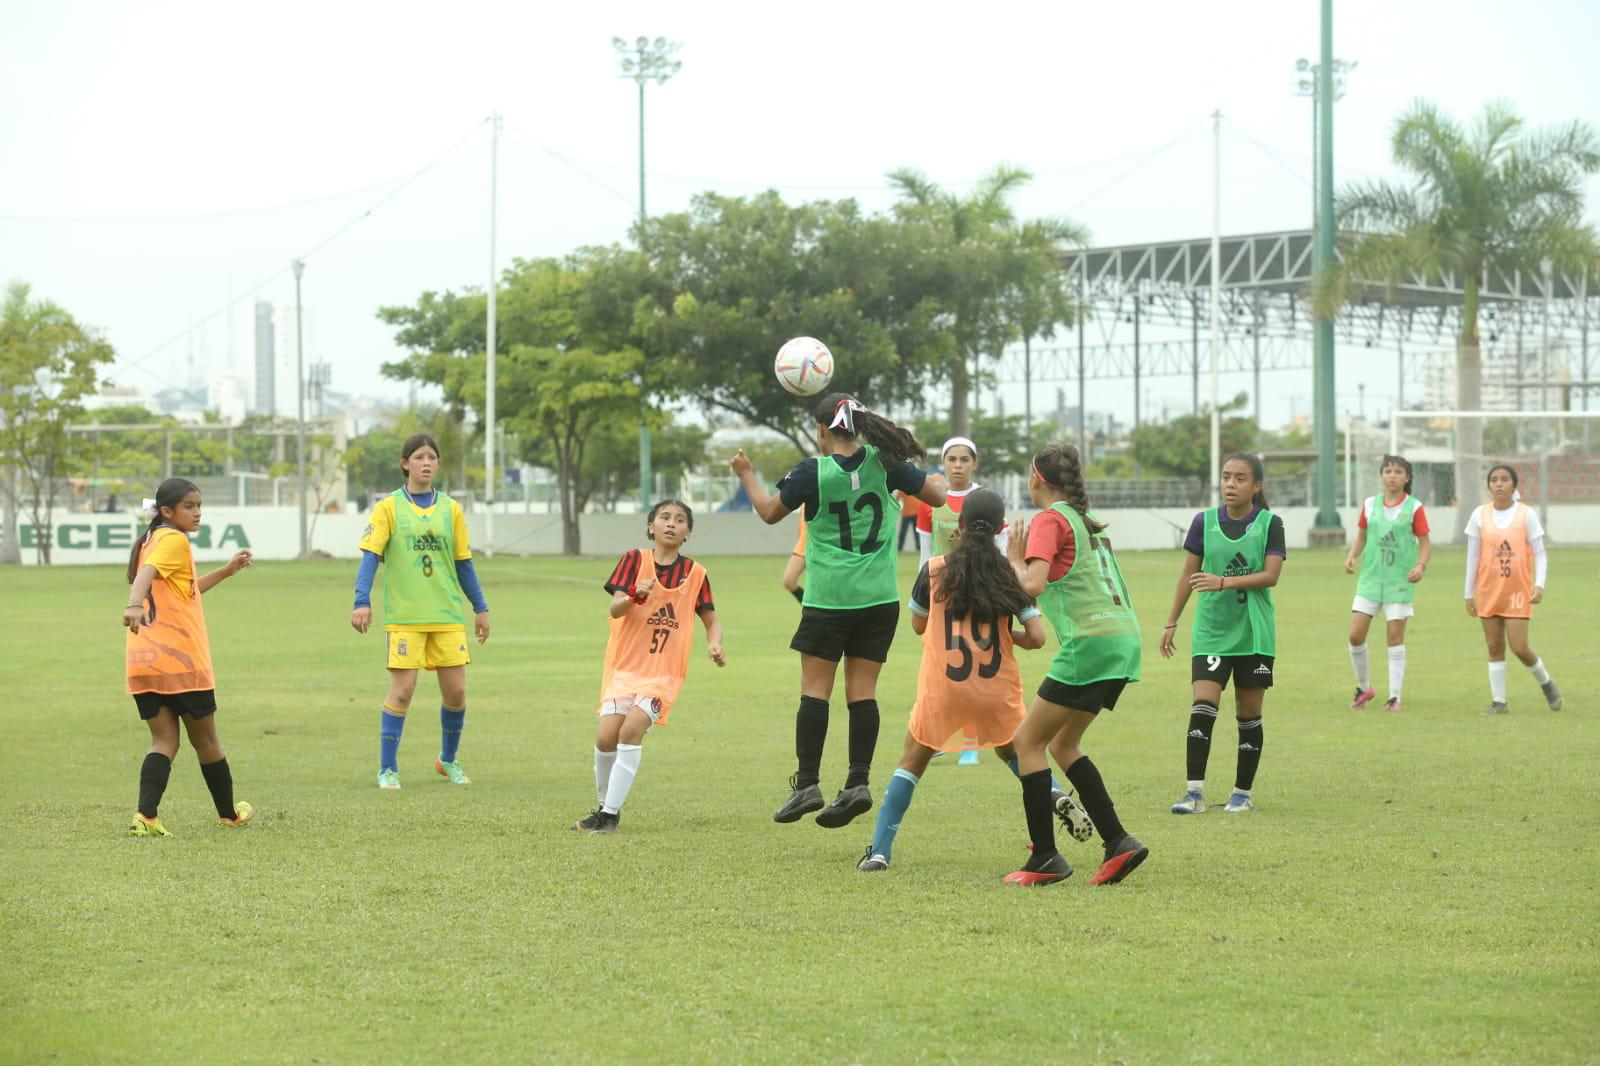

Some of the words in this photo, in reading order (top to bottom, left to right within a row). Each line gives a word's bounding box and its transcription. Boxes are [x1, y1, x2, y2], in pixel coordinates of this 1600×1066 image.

[828, 491, 887, 555] 12
[421, 554, 433, 578] 8
[646, 616, 680, 630] adidas
[649, 628, 671, 654] 57
[944, 608, 1002, 682] 59
[1206, 655, 1221, 671] 9
